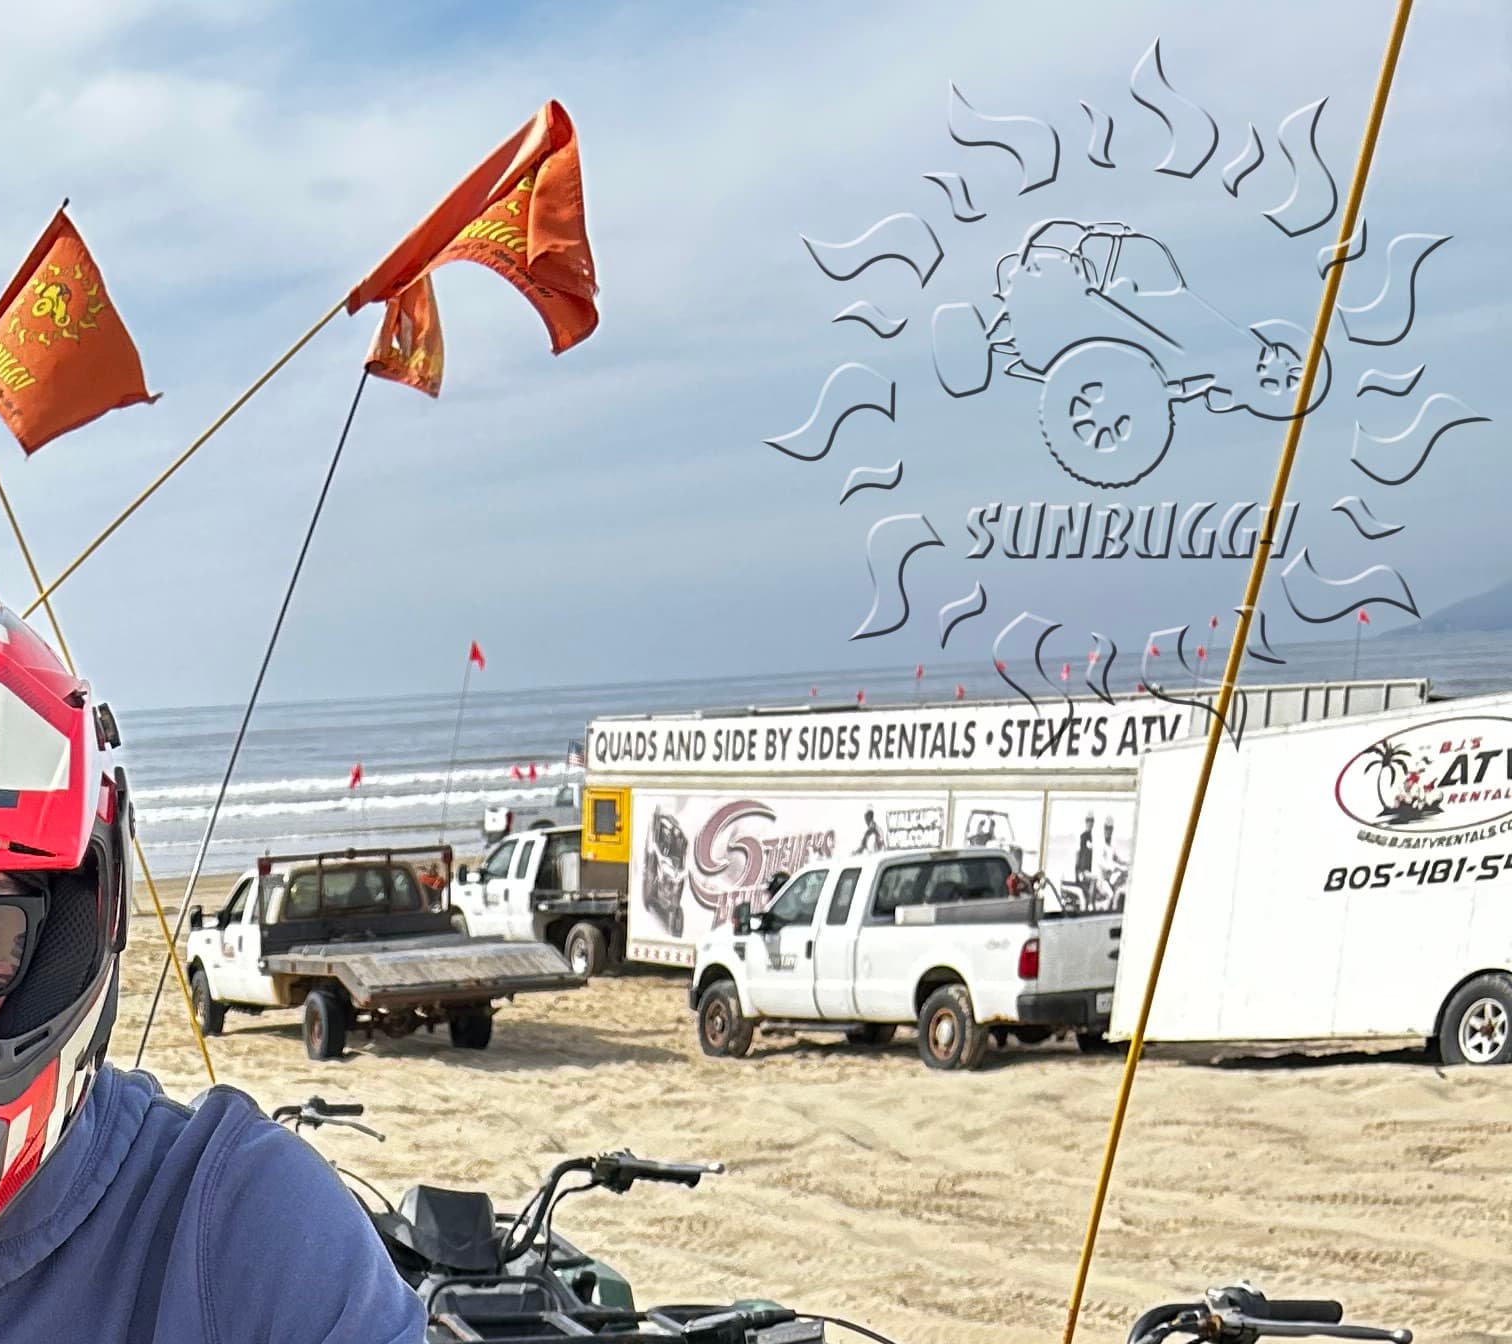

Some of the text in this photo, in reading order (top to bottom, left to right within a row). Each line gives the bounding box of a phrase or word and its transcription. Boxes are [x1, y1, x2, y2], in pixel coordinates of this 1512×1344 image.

[595, 714, 1183, 764] QUADS AND SIDE BY SIDES RENTALS STEVE'S ATV
[1437, 748, 1512, 788] AT
